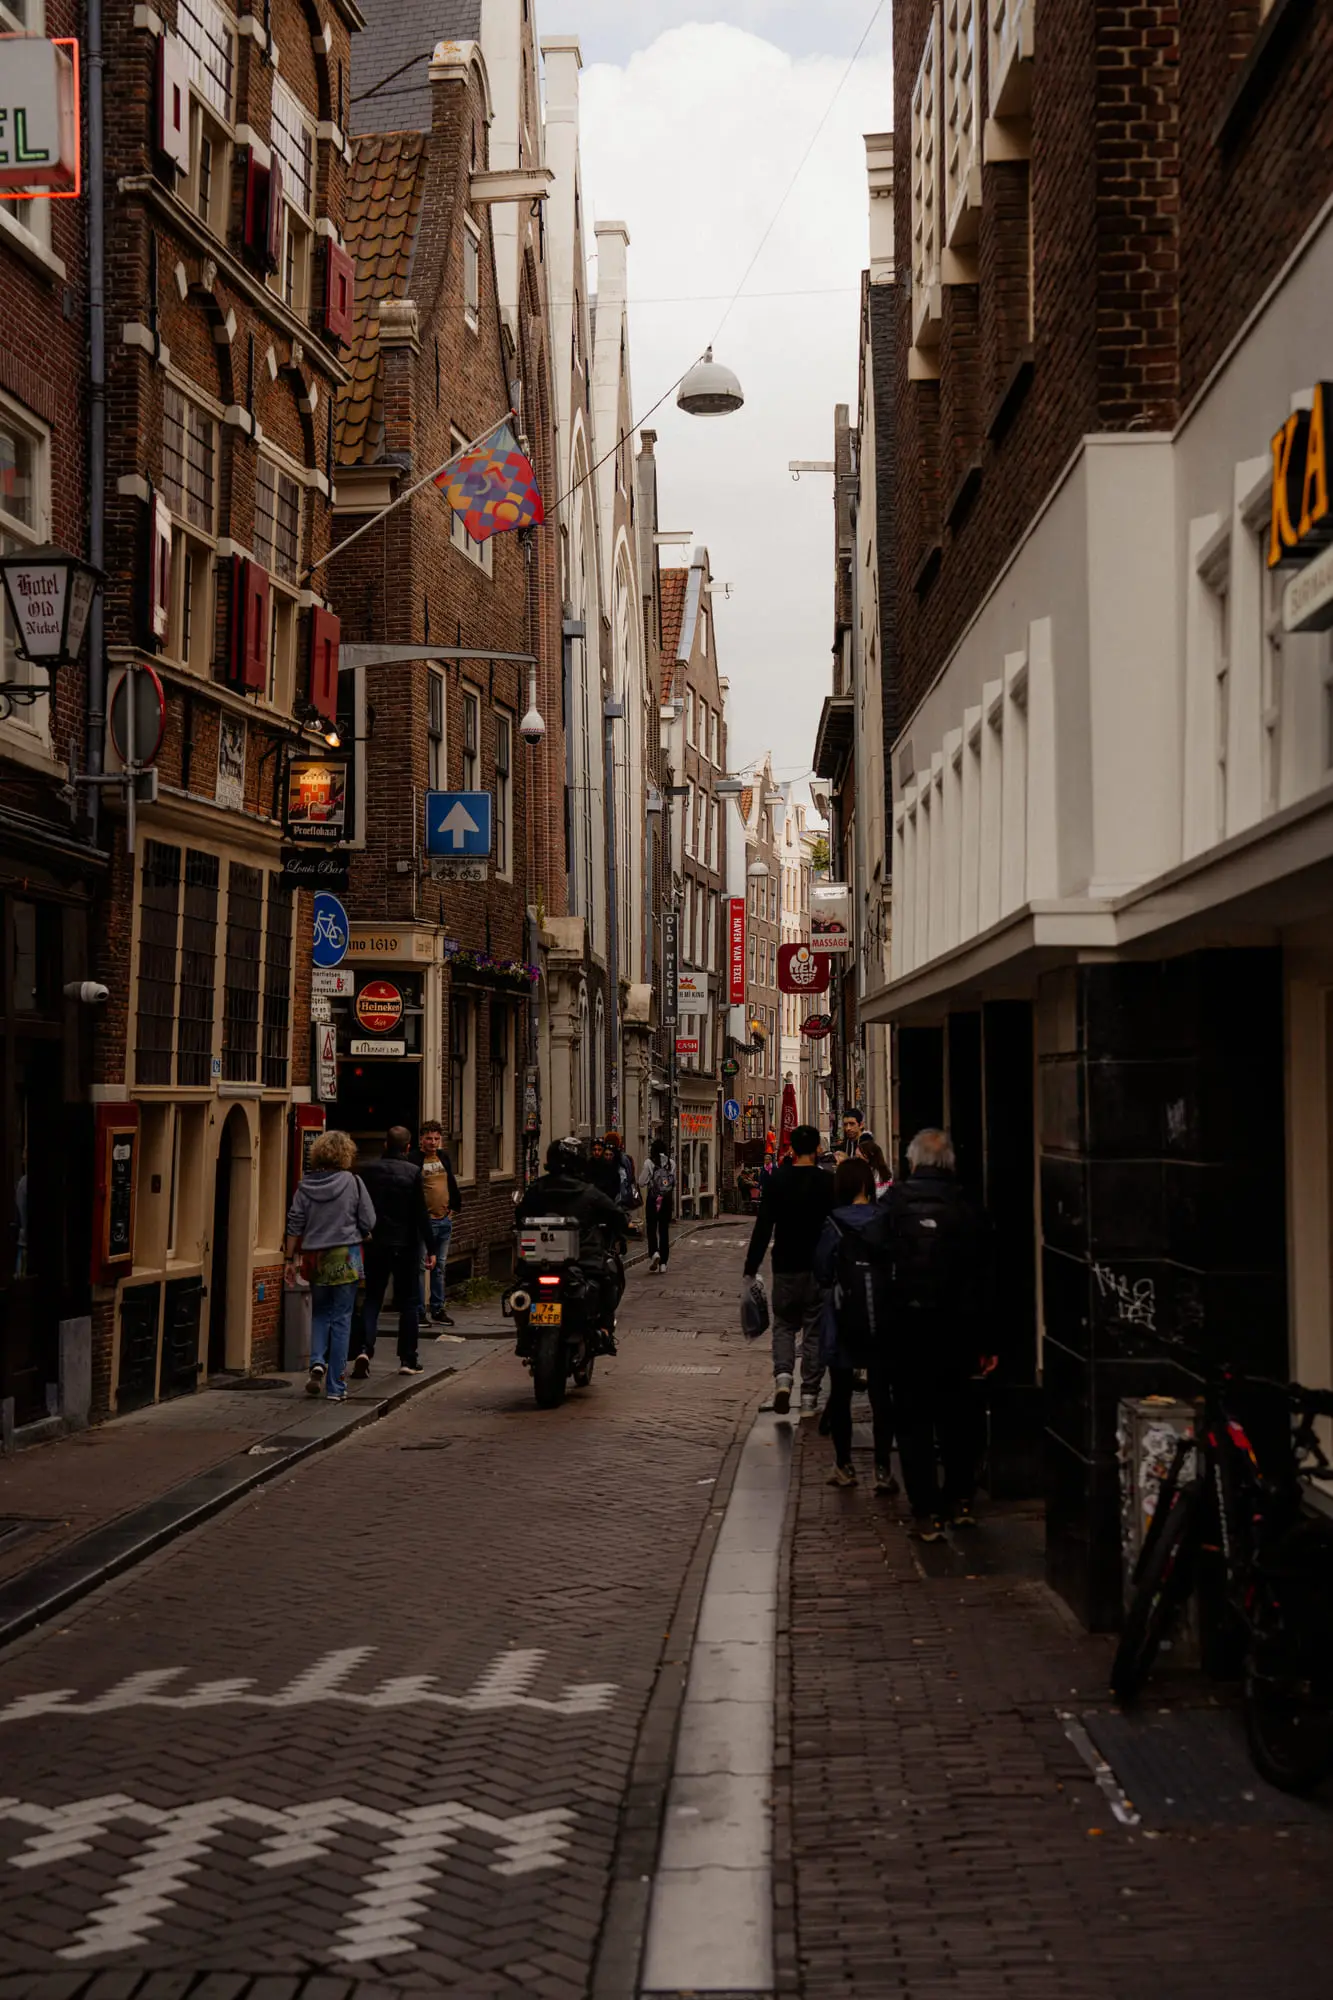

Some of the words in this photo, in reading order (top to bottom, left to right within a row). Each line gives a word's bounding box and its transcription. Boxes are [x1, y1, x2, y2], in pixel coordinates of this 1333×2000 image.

[0, 108, 49, 162] L
[17, 574, 59, 600] Hotel
[28, 601, 54, 618] Old
[26, 621, 60, 635] Nickel
[293, 825, 337, 836] Proeflokaal
[287, 859, 315, 874] Louis
[318, 860, 345, 875] Bar
[666, 917, 675, 942] OLD
[733, 918, 742, 943] HAVEN
[370, 938, 398, 951] 1619
[812, 938, 848, 948] MASSAGE
[733, 945, 742, 961] VAN
[666, 953, 675, 1006] NICKEL
[733, 964, 742, 985] TEXEL
[361, 1002, 400, 1011] Heineken
[665, 1016, 676, 1024] 19
[542, 1304, 554, 1312] 74
